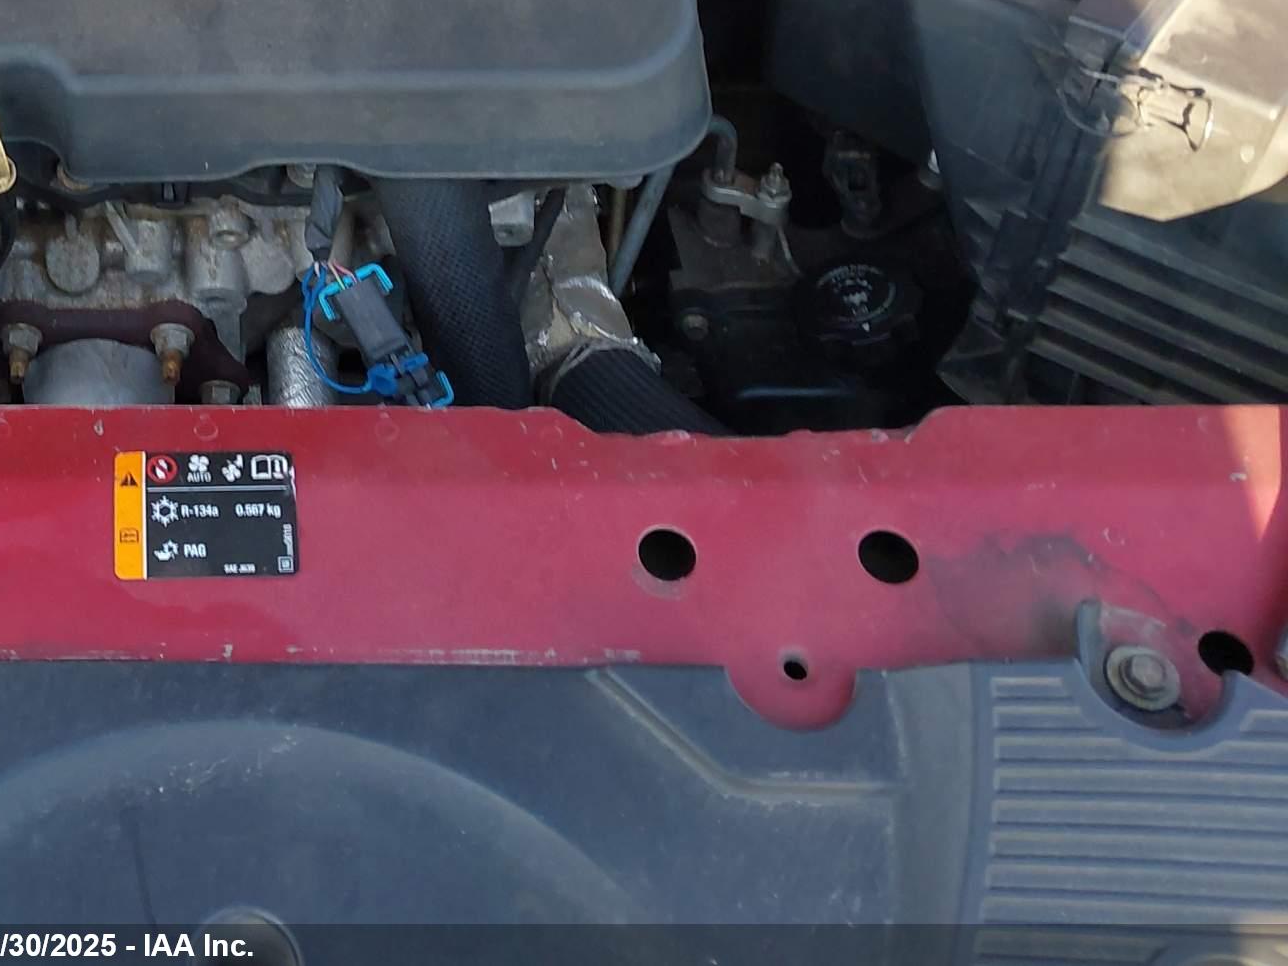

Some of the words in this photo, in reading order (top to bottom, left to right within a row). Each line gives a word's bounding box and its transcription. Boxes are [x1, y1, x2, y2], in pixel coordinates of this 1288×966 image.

[187, 472, 212, 483] AUTO
[181, 504, 220, 518] R-134a
[266, 503, 281, 519] kg
[184, 543, 207, 558] PAG
